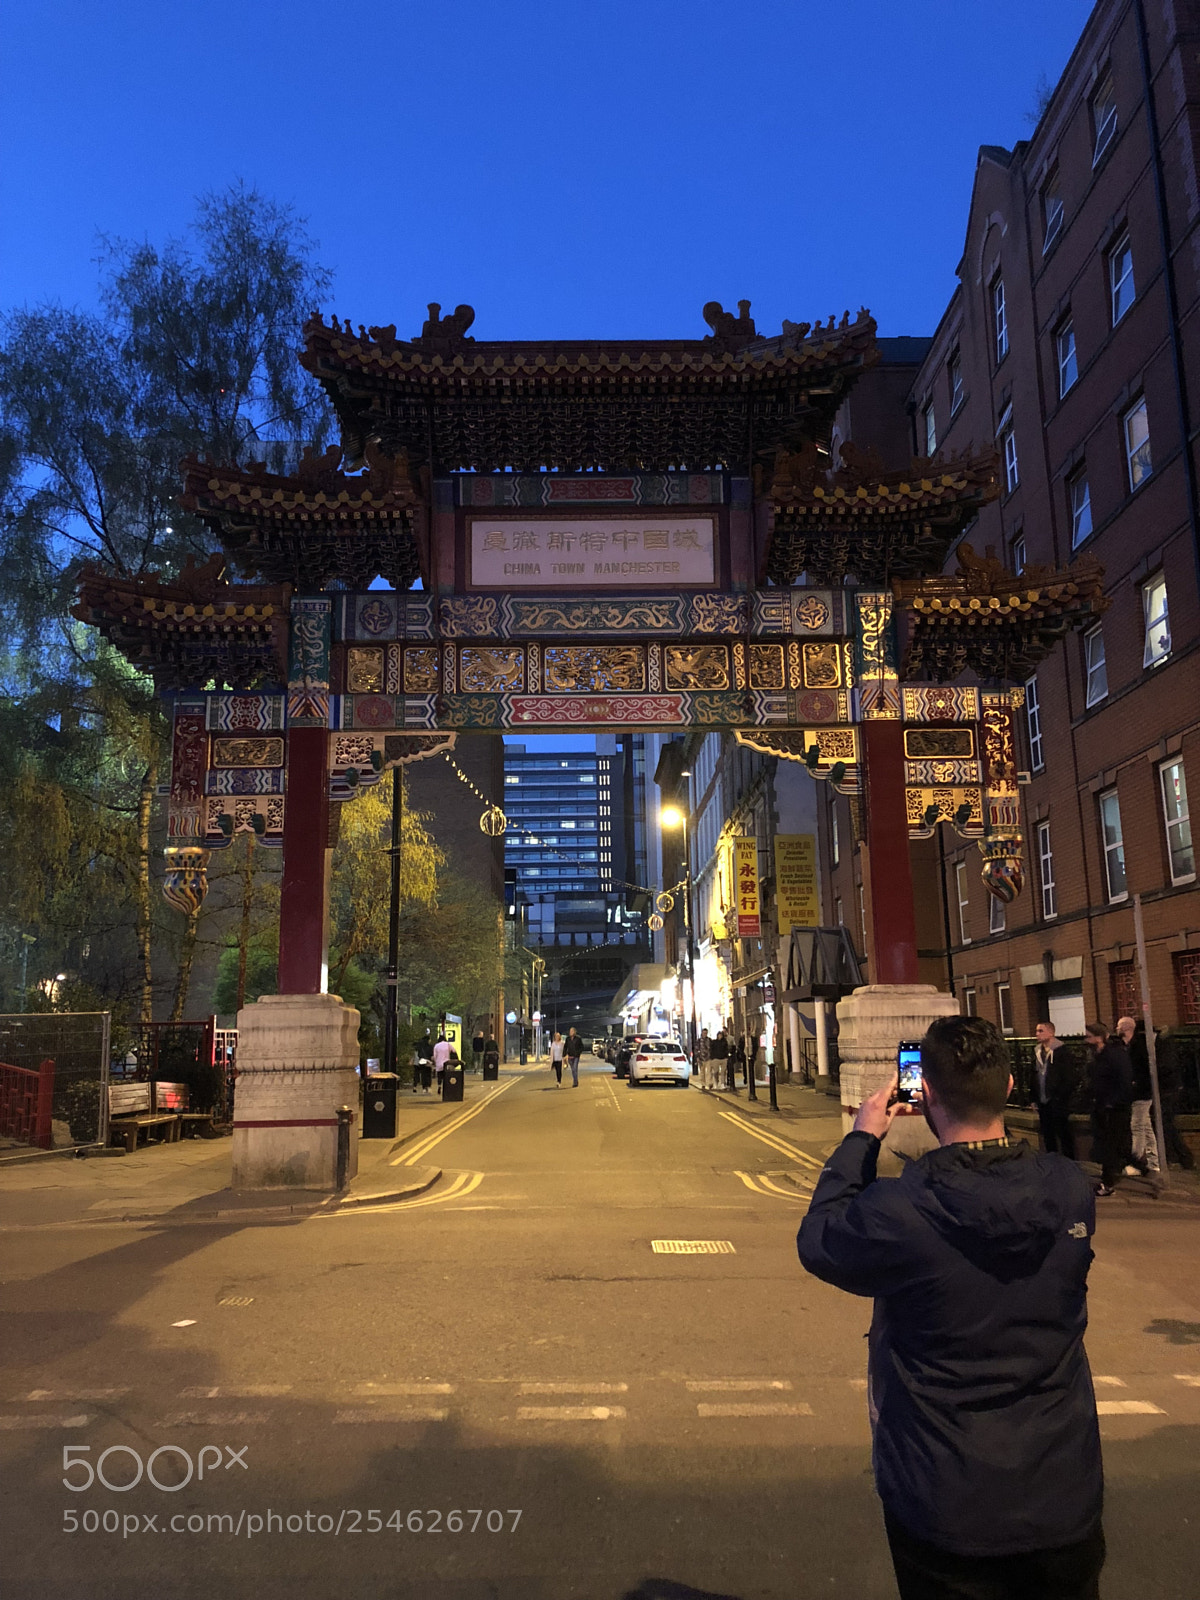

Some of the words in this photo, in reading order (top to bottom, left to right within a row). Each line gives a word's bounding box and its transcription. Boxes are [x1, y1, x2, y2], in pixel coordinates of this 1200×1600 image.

[503, 562, 541, 575] CHINA
[551, 562, 585, 575] TOWN
[594, 561, 681, 576] MANCHESTER
[736, 842, 756, 850] WING
[740, 863, 757, 910] 永發行
